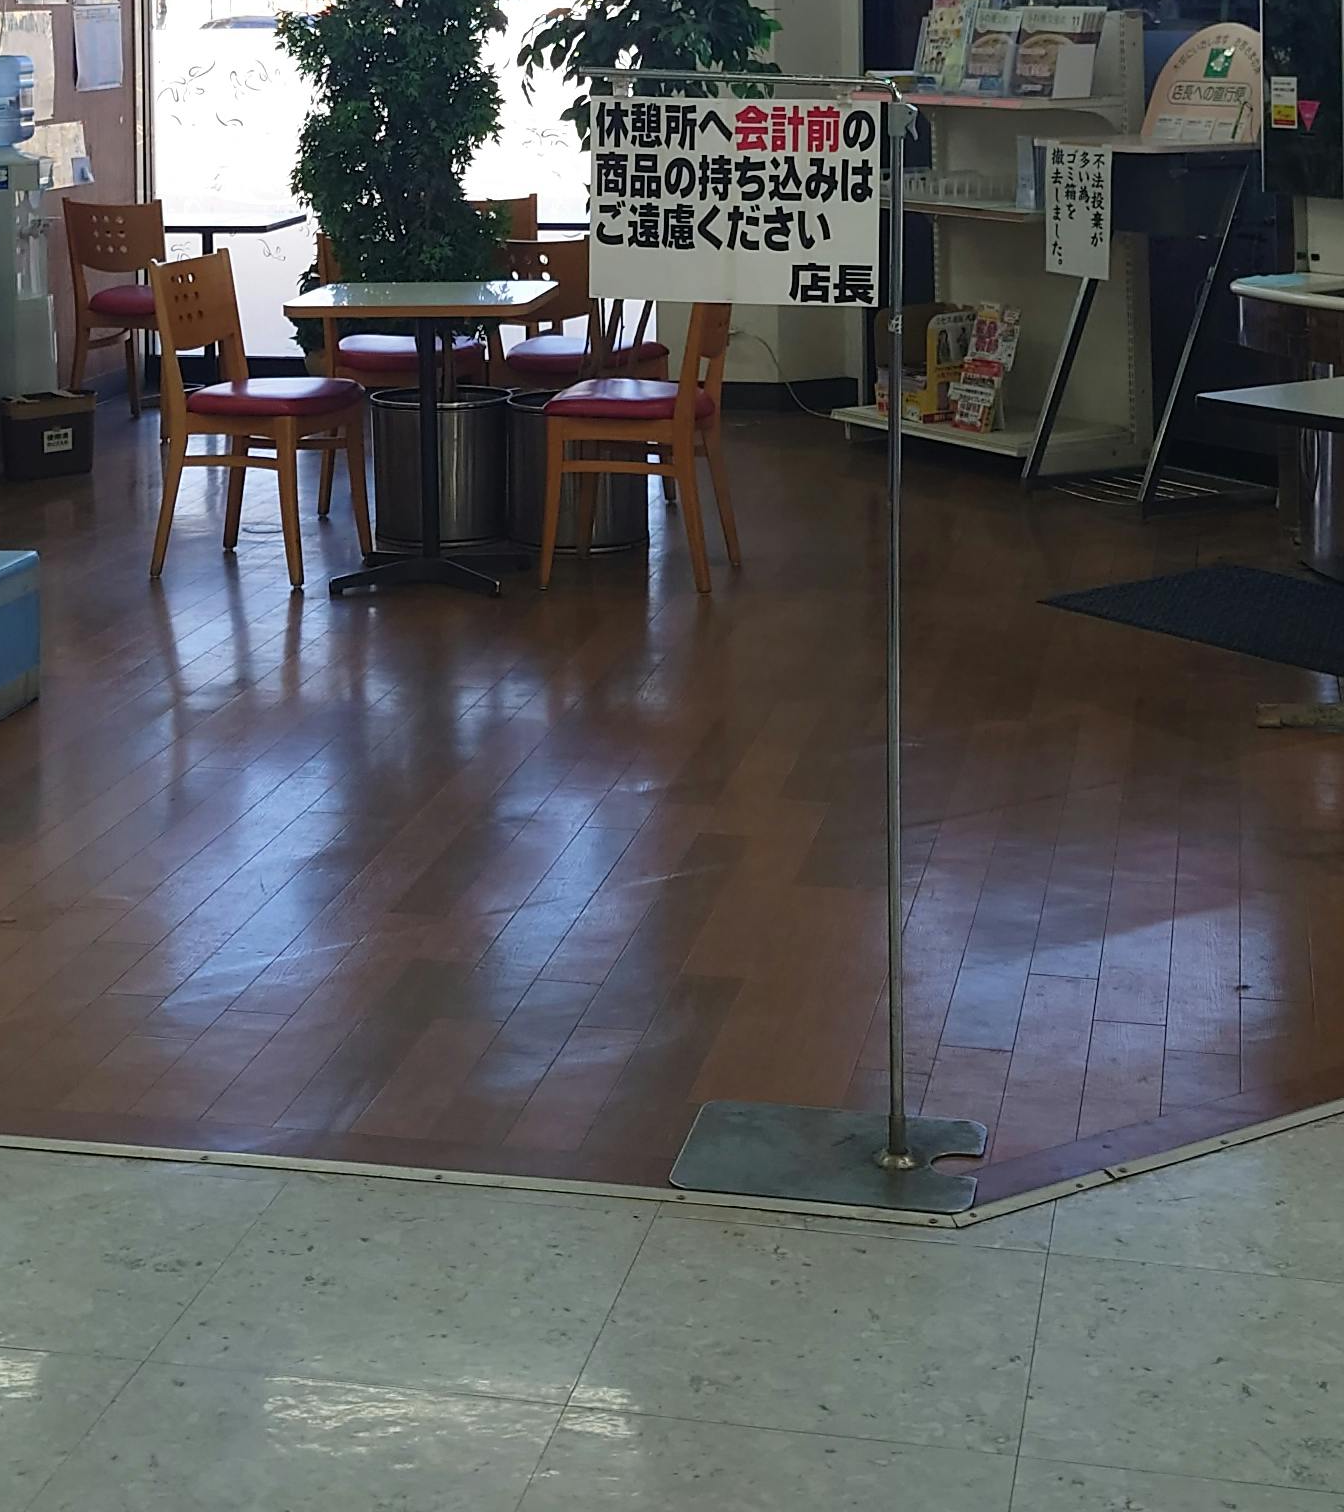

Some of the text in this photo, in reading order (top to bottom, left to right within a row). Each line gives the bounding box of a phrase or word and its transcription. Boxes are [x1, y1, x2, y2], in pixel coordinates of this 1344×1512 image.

[596, 101, 876, 153] 休憩所へ会計前の
[596, 153, 874, 202] 商品の持ち込みは
[1065, 150, 1078, 220] ゴミ箱を
[1091, 153, 1104, 247] 不法投棄が
[596, 201, 830, 251] ご遠慮ください
[1051, 148, 1064, 265] 撤去しました。
[789, 263, 874, 304] 店長
